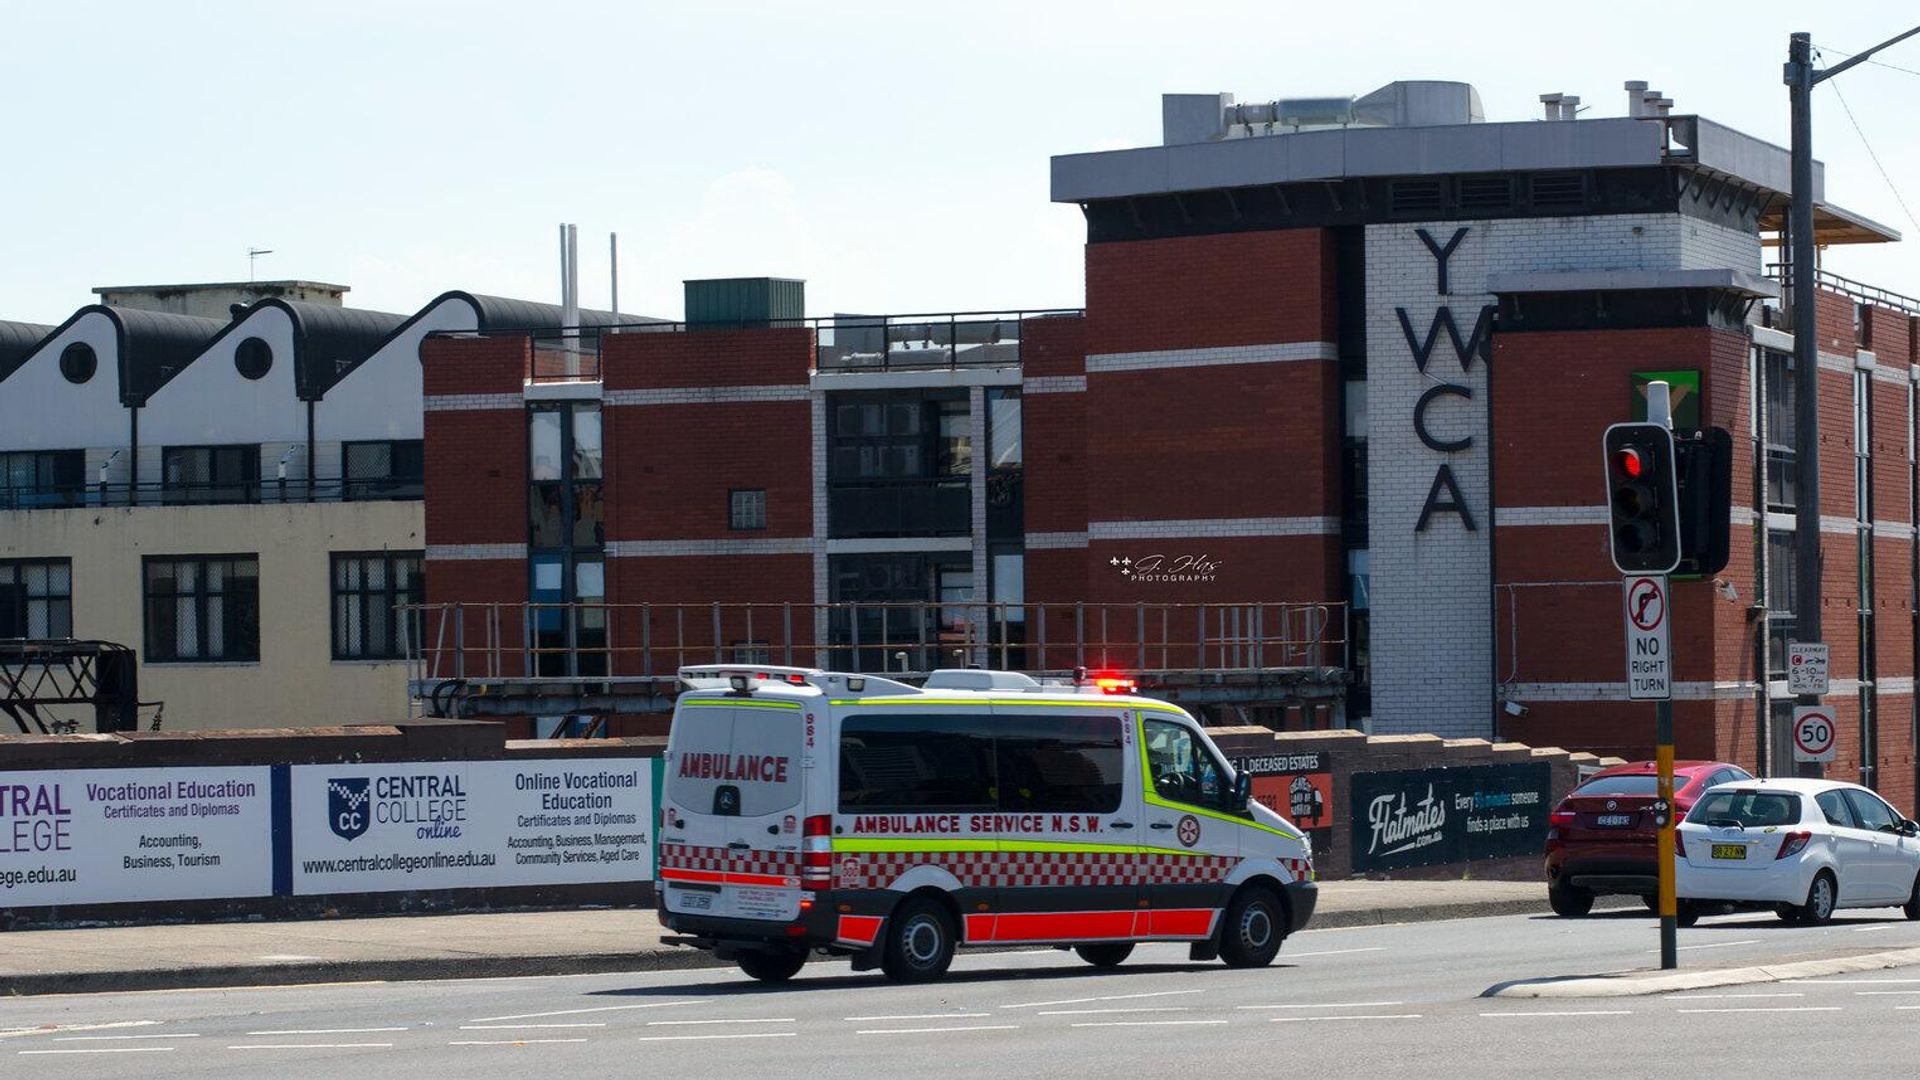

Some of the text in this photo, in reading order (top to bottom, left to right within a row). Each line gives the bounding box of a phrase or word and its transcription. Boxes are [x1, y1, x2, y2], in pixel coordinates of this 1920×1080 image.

[1395, 227, 1498, 532] YWCA
[1636, 638, 1660, 655] NO
[1632, 660, 1665, 673] RIGHT
[1634, 678, 1665, 691] TURN
[1802, 725, 1828, 743] 50
[679, 752, 789, 783] AMBULANCE
[1249, 758, 1288, 773] DECEASED
[1289, 755, 1319, 771] ESTATES
[376, 775, 466, 798] CENTRAL
[515, 771, 638, 790] Online Vocational
[0, 784, 71, 816] TRAL
[87, 781, 256, 801] Vocational Education
[104, 803, 240, 819] Certificates and Diplomas
[542, 793, 612, 810] Education
[1455, 793, 1474, 812] Every
[1511, 792, 1539, 805] someone
[376, 799, 467, 824] COLLEGE
[517, 812, 637, 828] Certificates and Diplomas
[1368, 782, 1446, 855] Flatmates
[338, 812, 361, 831] CC
[416, 815, 462, 840] online
[853, 814, 1104, 834] AMBULANCE SERVICE N.S.W.
[1467, 816, 1483, 833] finds
[1489, 815, 1506, 834] place
[1507, 813, 1520, 829] with
[1521, 816, 1529, 828] us
[139, 834, 202, 850] Accounting,
[508, 832, 647, 849] Accounting, Business, Management,
[123, 853, 221, 870] Business, Tourism
[303, 851, 496, 874] www.centralcollegeonline.edu.au
[516, 852, 561, 866] Community
[600, 849, 620, 864] Aged
[621, 849, 640, 862] Care
